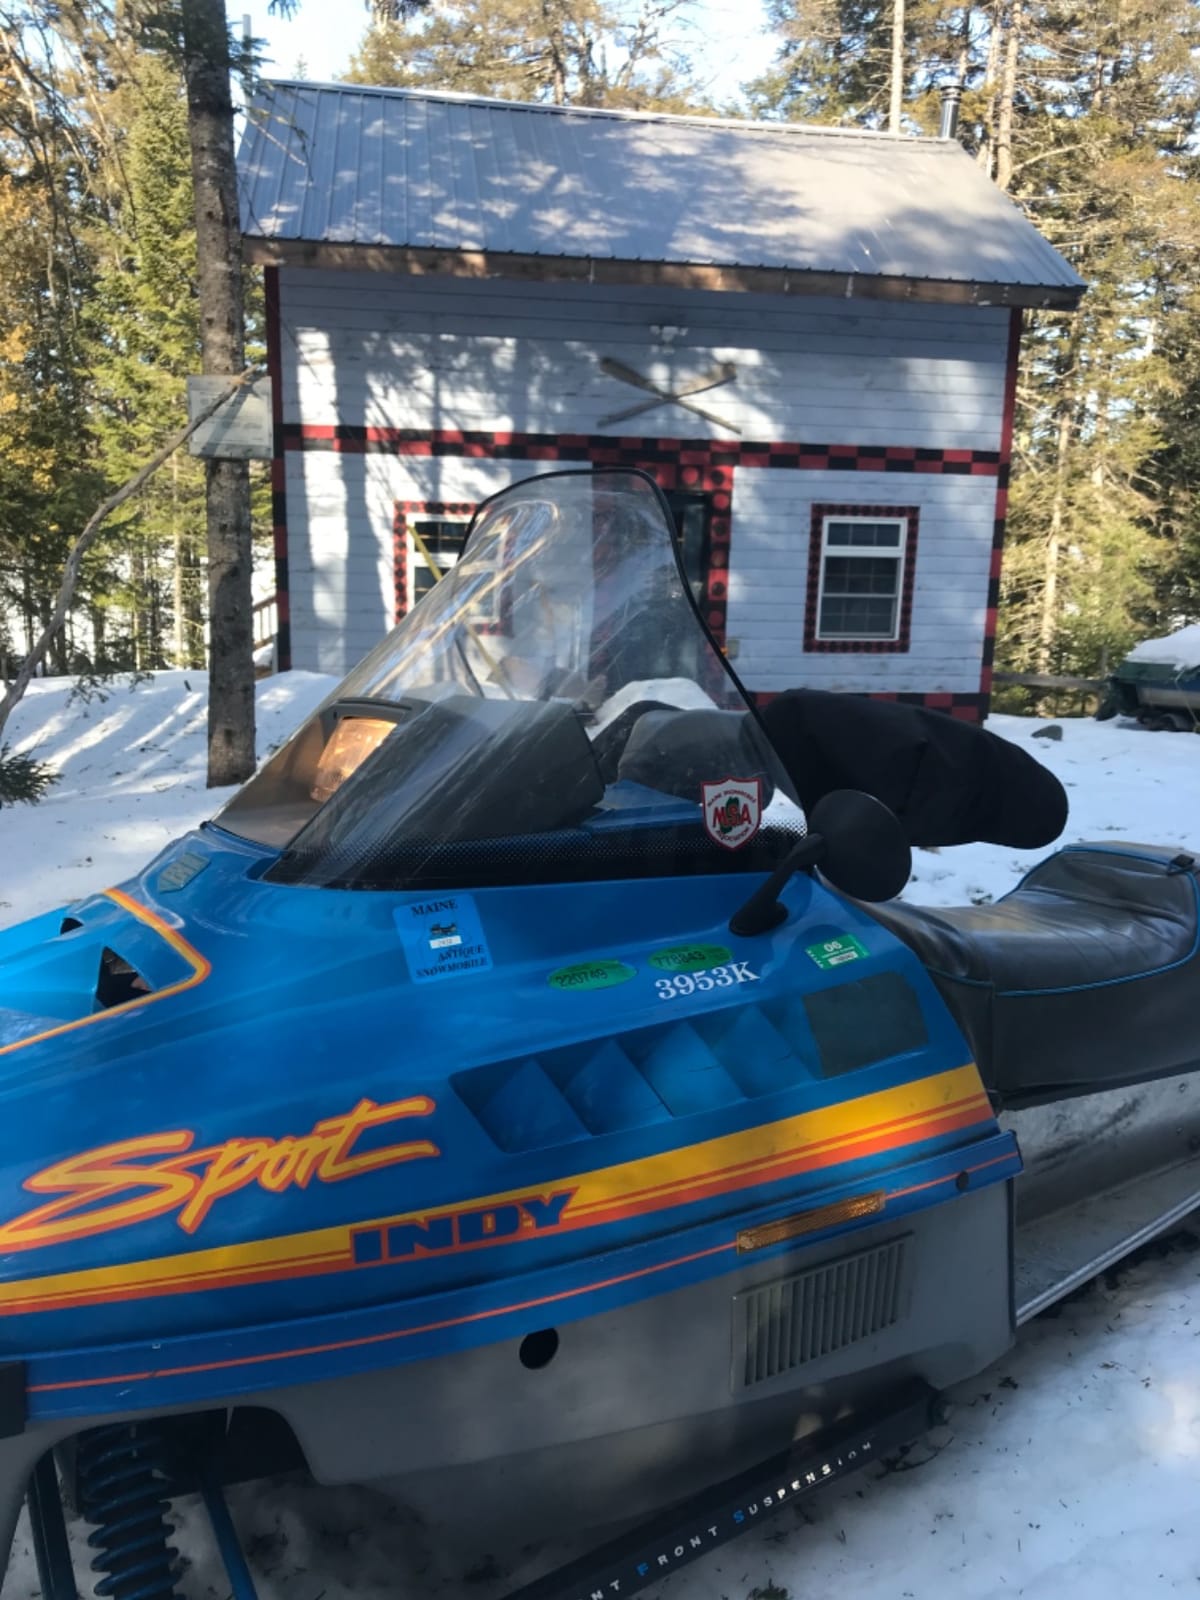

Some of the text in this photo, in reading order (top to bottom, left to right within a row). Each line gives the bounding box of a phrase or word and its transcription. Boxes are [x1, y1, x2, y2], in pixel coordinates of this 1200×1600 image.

[411, 899, 458, 916] MAINE
[415, 957, 488, 977] SNOWMOBILE
[438, 944, 485, 962] ANTIQUE
[655, 961, 760, 1000] 3953K
[0, 1095, 440, 1254] Sport
[351, 1187, 580, 1266] INDY
[635, 1525, 719, 1576] FRONT
[733, 1441, 872, 1523] SUSPENSION
